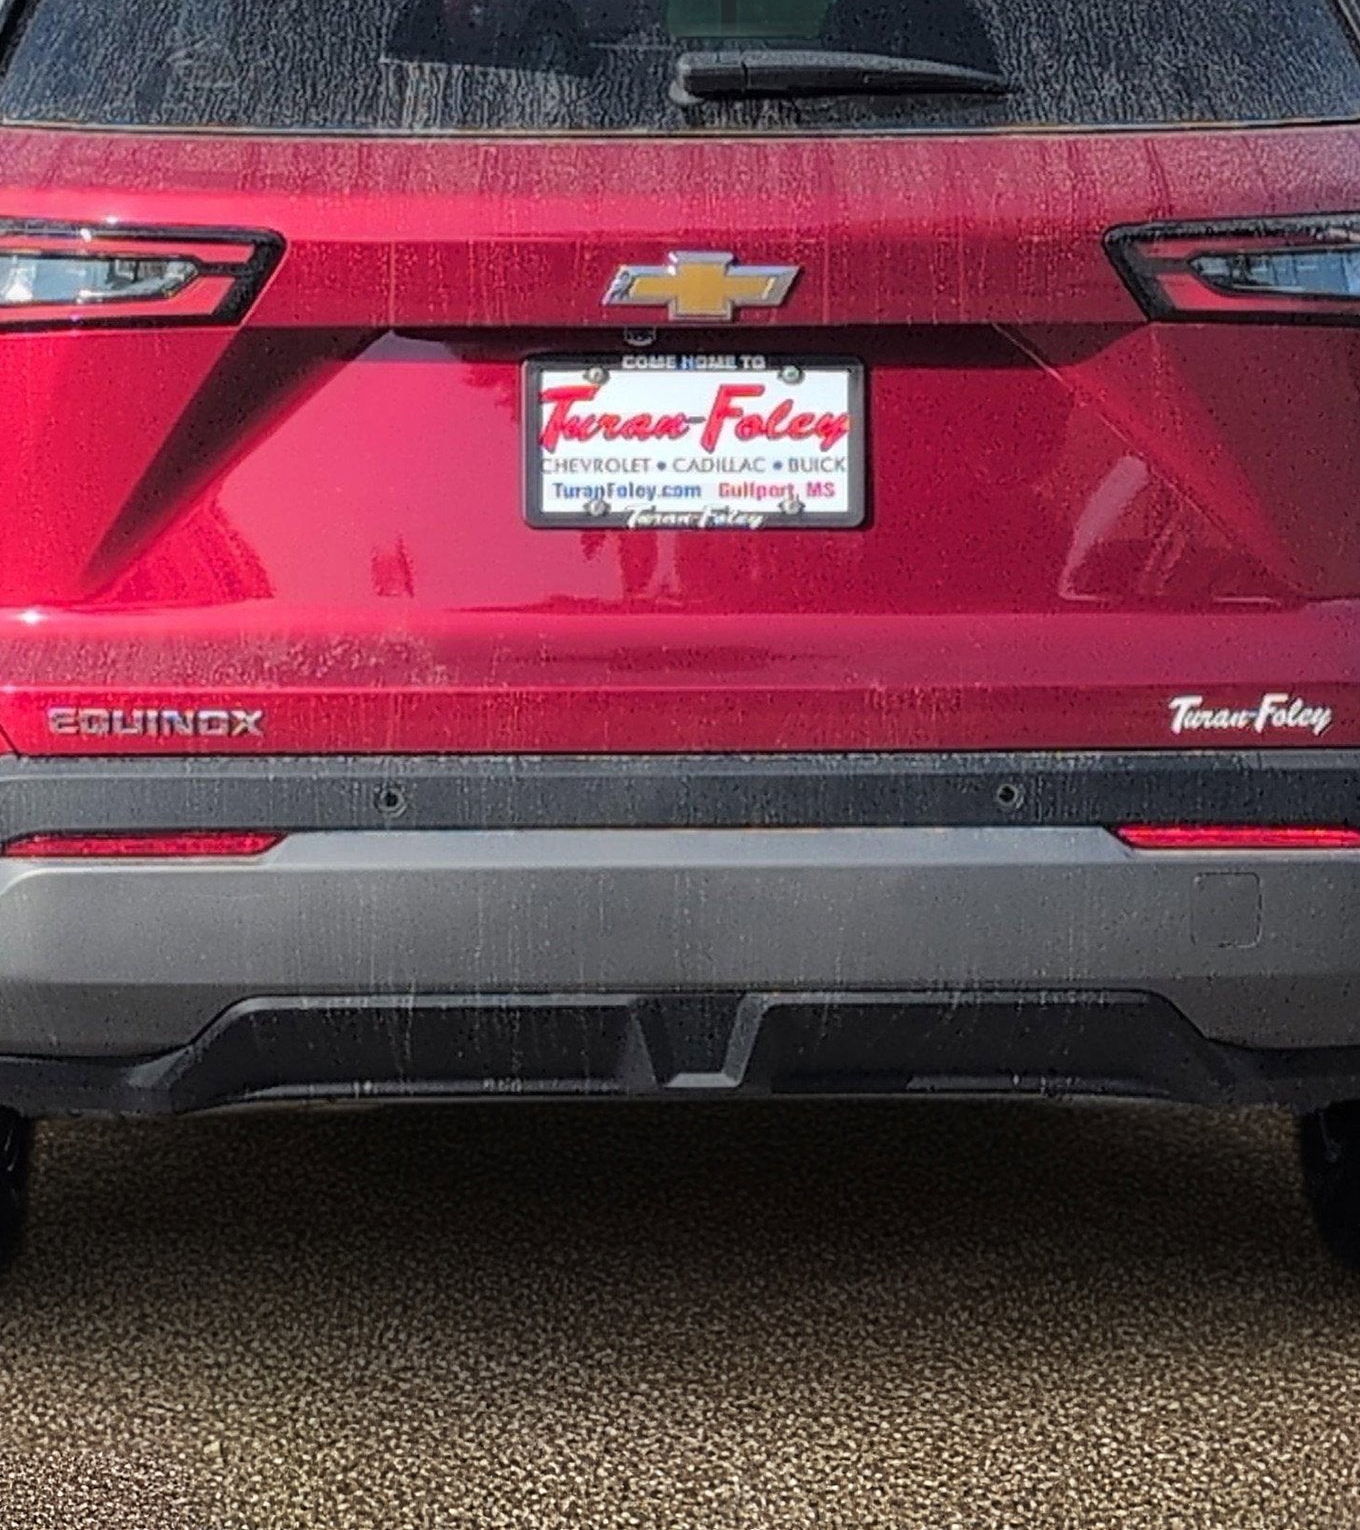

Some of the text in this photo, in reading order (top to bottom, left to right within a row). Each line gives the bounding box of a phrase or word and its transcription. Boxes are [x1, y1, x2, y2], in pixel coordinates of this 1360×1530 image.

[622, 354, 766, 370] COME HOME TO
[538, 383, 851, 454] Turan-Foley
[541, 457, 846, 474] CHEVROLET CADILLAC BUICK
[553, 482, 702, 500] TuranFoley.com
[806, 482, 836, 499] MS
[48, 707, 263, 736] EQUINOX
[1169, 693, 1332, 736] Turan-Foley
